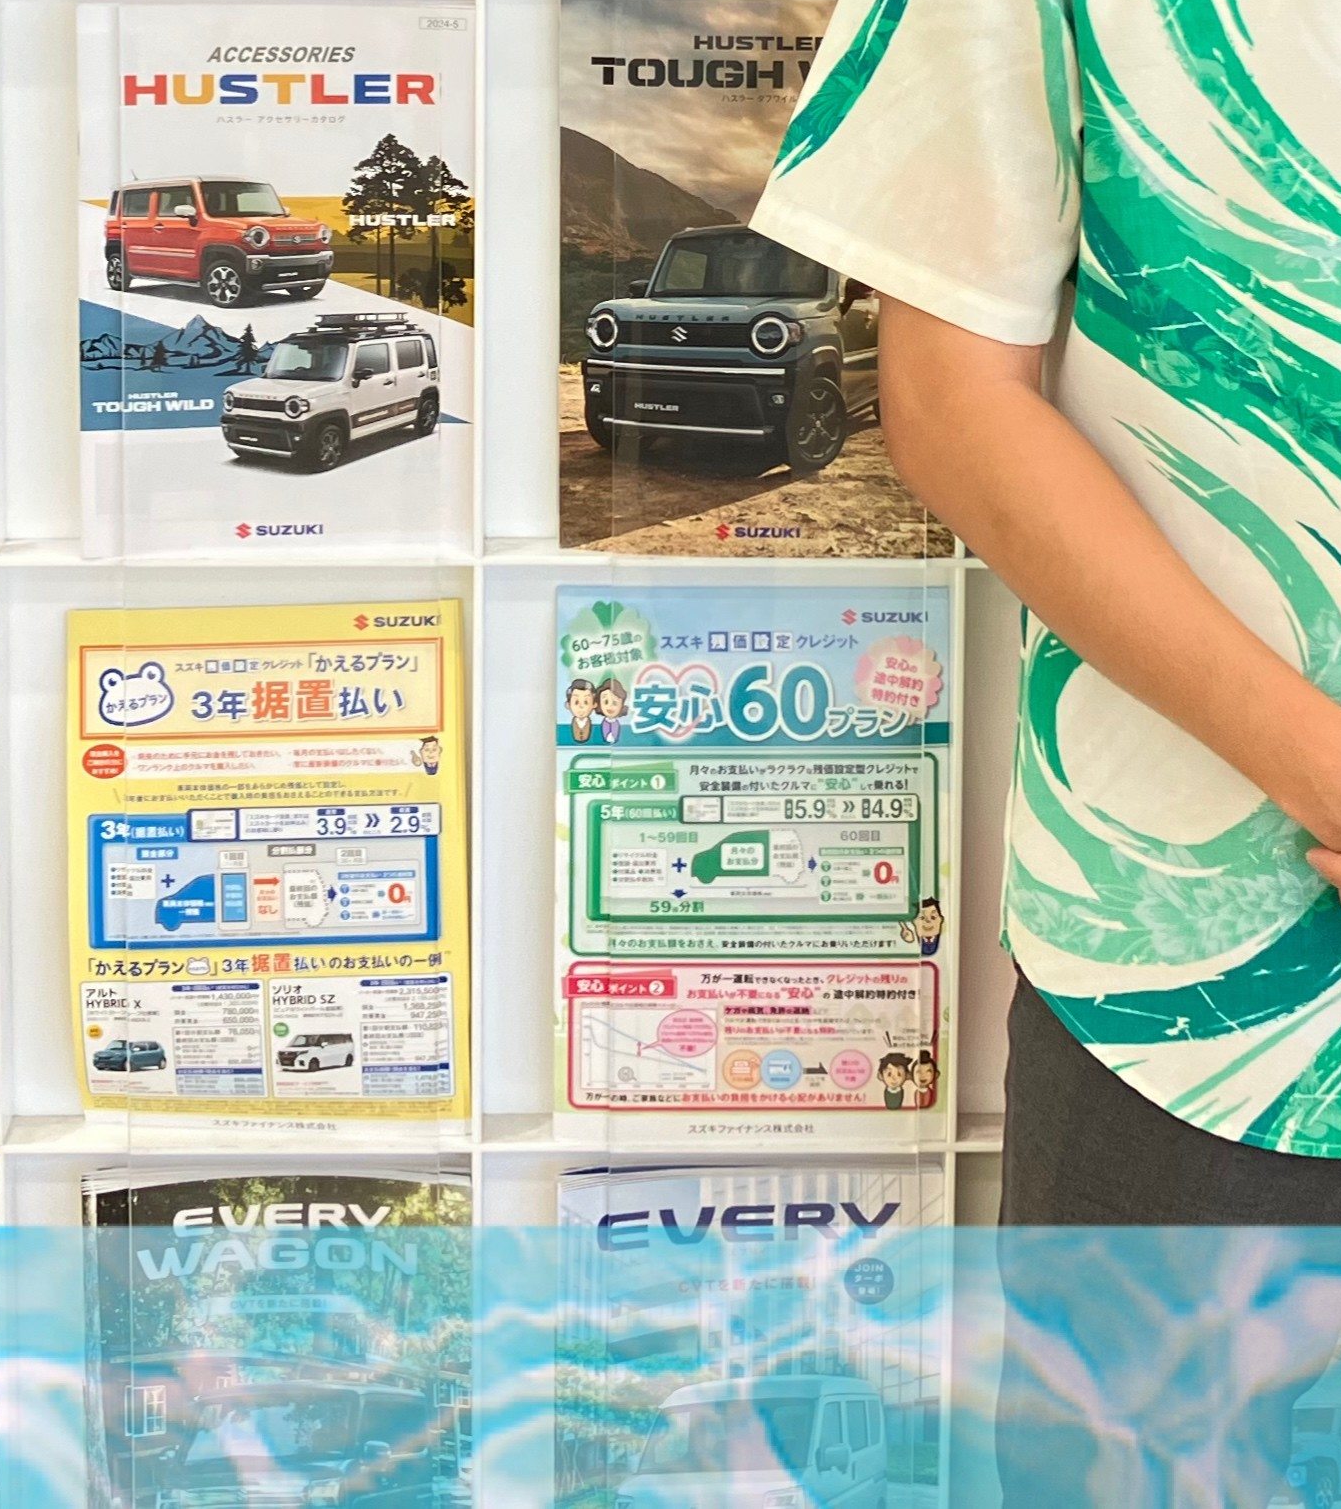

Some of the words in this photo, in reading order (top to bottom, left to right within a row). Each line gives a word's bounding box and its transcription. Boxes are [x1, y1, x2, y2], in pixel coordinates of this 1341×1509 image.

[206, 46, 357, 64] ACCESSORIES
[590, 56, 785, 90] TOUGH
[122, 73, 436, 106] HUSTLER
[215, 114, 252, 125] ハスラー
[349, 213, 457, 228] HUSTLER
[92, 399, 161, 414] TOUGH
[162, 397, 215, 412] WILD
[633, 401, 681, 413] HUSTLER
[255, 523, 324, 537] SUZUKI
[734, 526, 801, 539] SUZUKI
[372, 614, 441, 629] SUZUKI
[860, 610, 929, 624] SUZUKI
[660, 634, 704, 650] スズキ
[174, 661, 204, 673] スズキ
[105, 693, 169, 715] かえるプラン
[190, 679, 404, 721] 3年据置払い
[631, 660, 911, 743] 安心60プラン
[794, 798, 826, 819] 5.9
[871, 797, 903, 819] 4.9
[316, 817, 346, 836] 3.9
[389, 815, 422, 835] 2.9
[839, 829, 882, 842] 60回目
[85, 988, 117, 999] アルト
[272, 984, 303, 995] ソリオ
[272, 994, 317, 1006] HYBRID
[320, 994, 337, 1005] SZ
[212, 1118, 339, 1132] スズキファイナンス株式会社
[687, 1122, 816, 1135] スズキファイナンス株式会社
[171, 1201, 393, 1239] EVERY
[595, 1200, 903, 1254] EVERY
[135, 1236, 419, 1281] WAGON
[853, 1263, 886, 1275] JOIN
